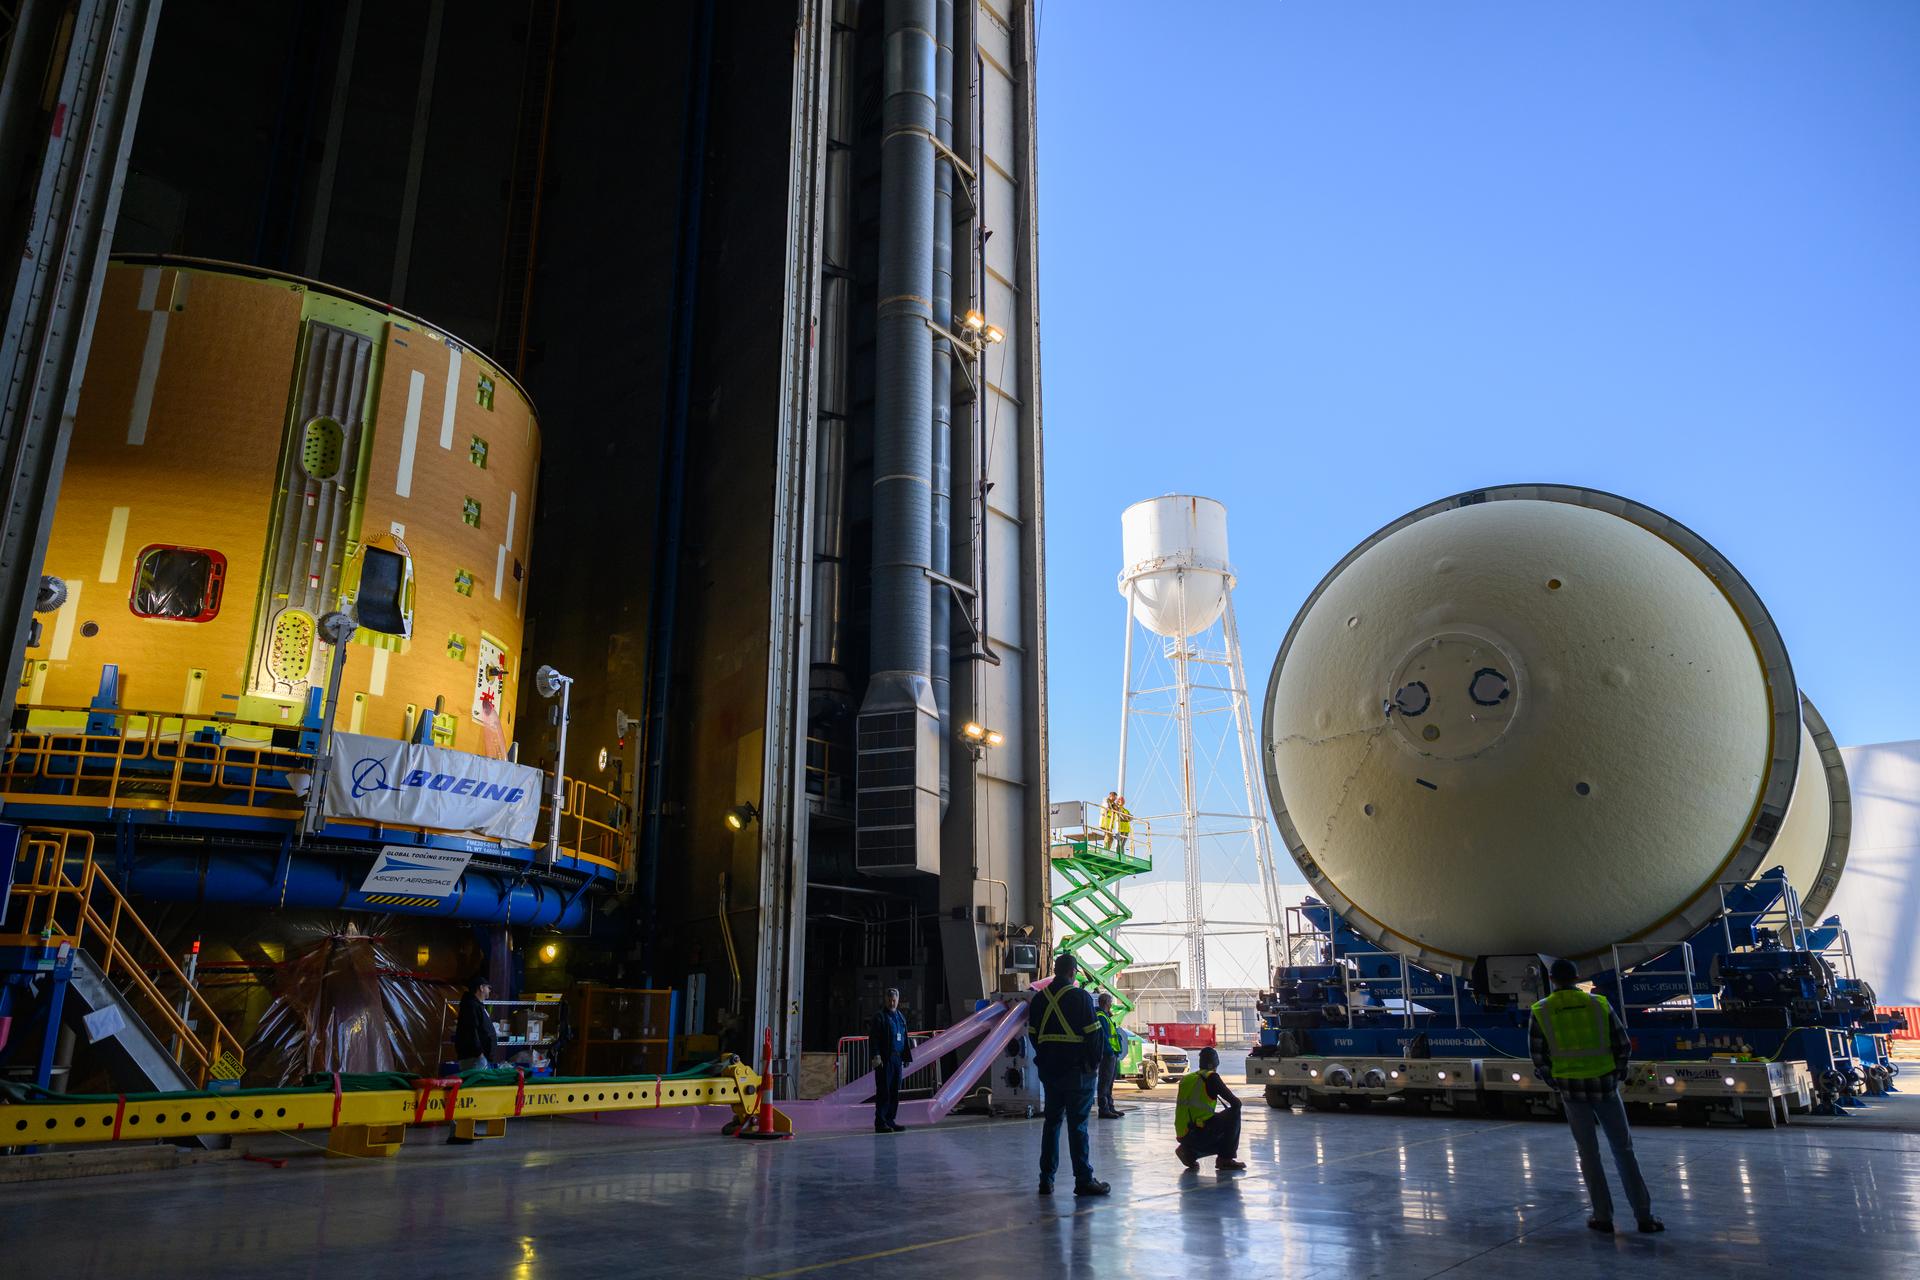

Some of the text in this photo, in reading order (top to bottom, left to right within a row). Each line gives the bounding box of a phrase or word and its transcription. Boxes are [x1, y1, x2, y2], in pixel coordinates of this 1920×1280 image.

[402, 769, 525, 803] BOEING
[386, 850, 465, 863] GLOBAL TOOLING SYSTEMS
[406, 877, 451, 886] AEROSPACE
[1675, 1069, 1722, 1079] Wheelift
[537, 1094, 559, 1105] INC.
